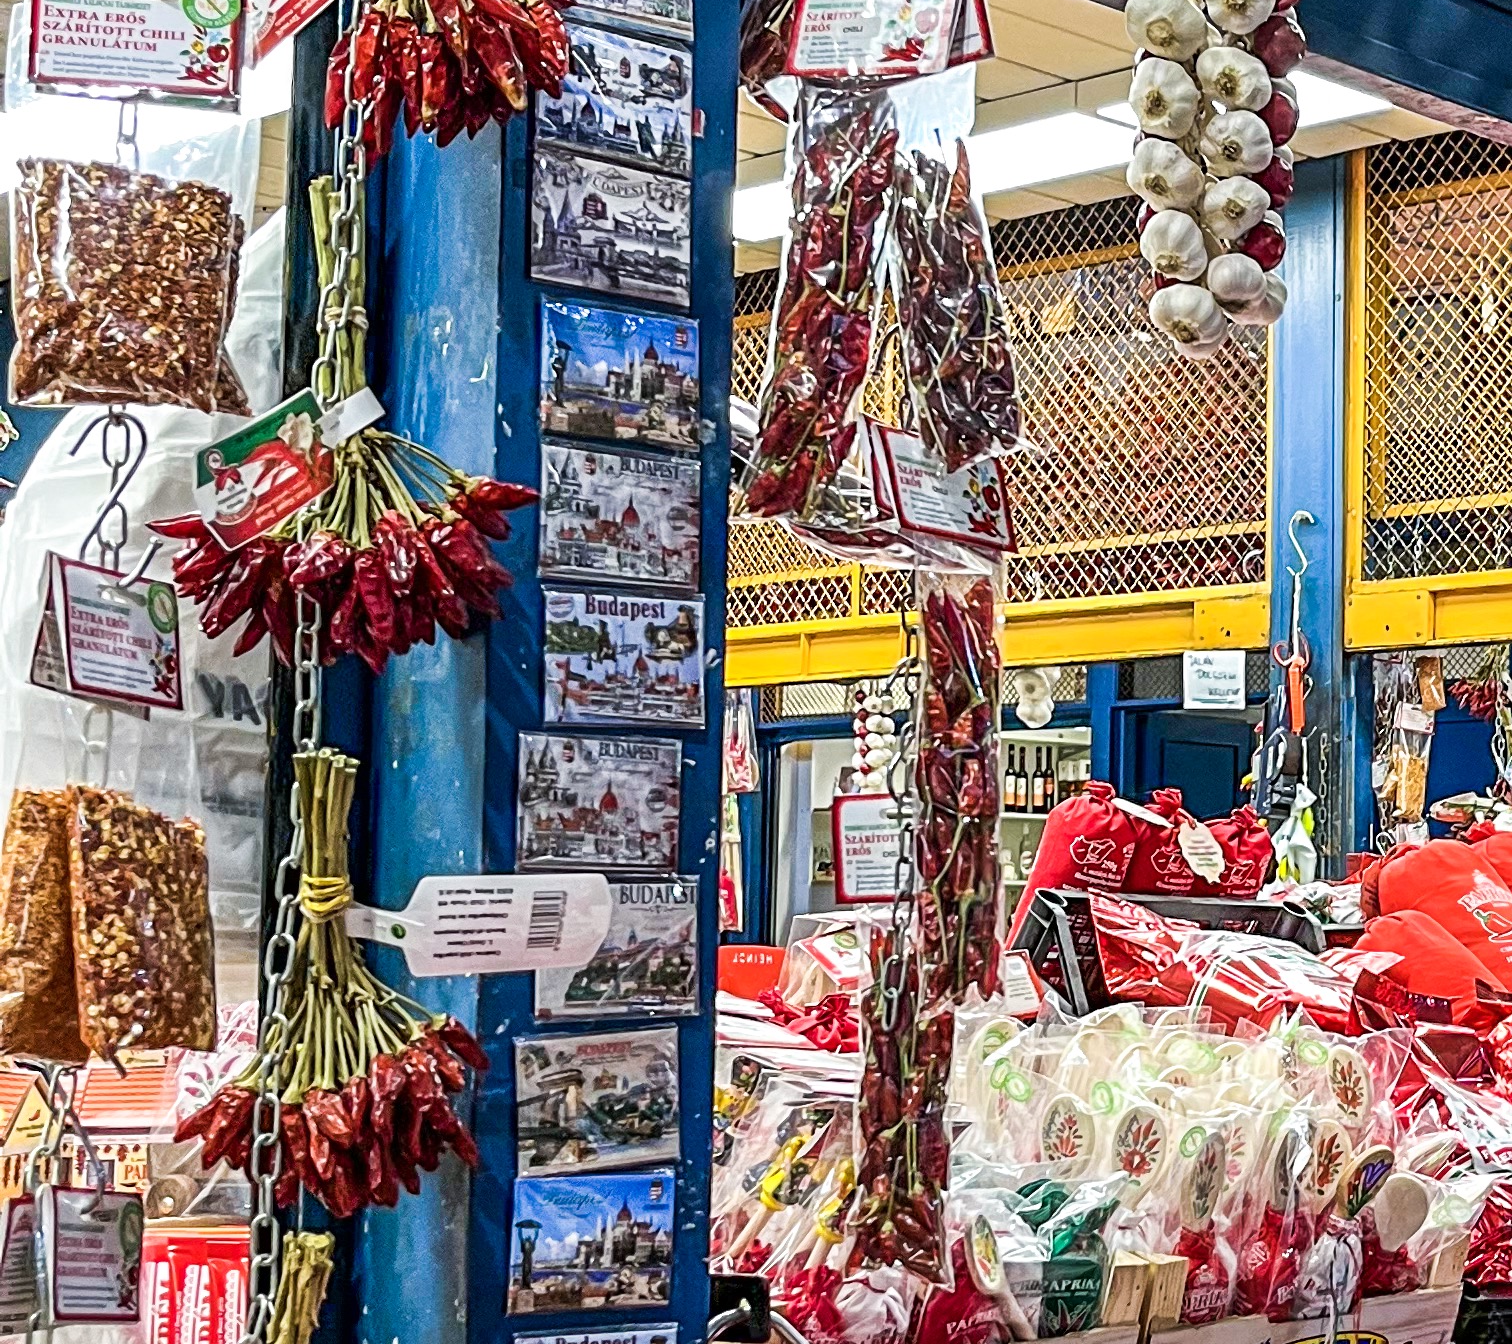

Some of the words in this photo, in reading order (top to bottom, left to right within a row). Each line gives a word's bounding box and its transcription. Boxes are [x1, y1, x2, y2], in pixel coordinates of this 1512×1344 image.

[44, 4, 99, 22] EXTRA
[105, 10, 147, 25] ERŐS
[42, 19, 135, 38] SZÁRÍTOTT
[140, 29, 186, 41] CHILI
[42, 34, 158, 52] GRANULÁTUM
[585, 593, 666, 621] Budapest
